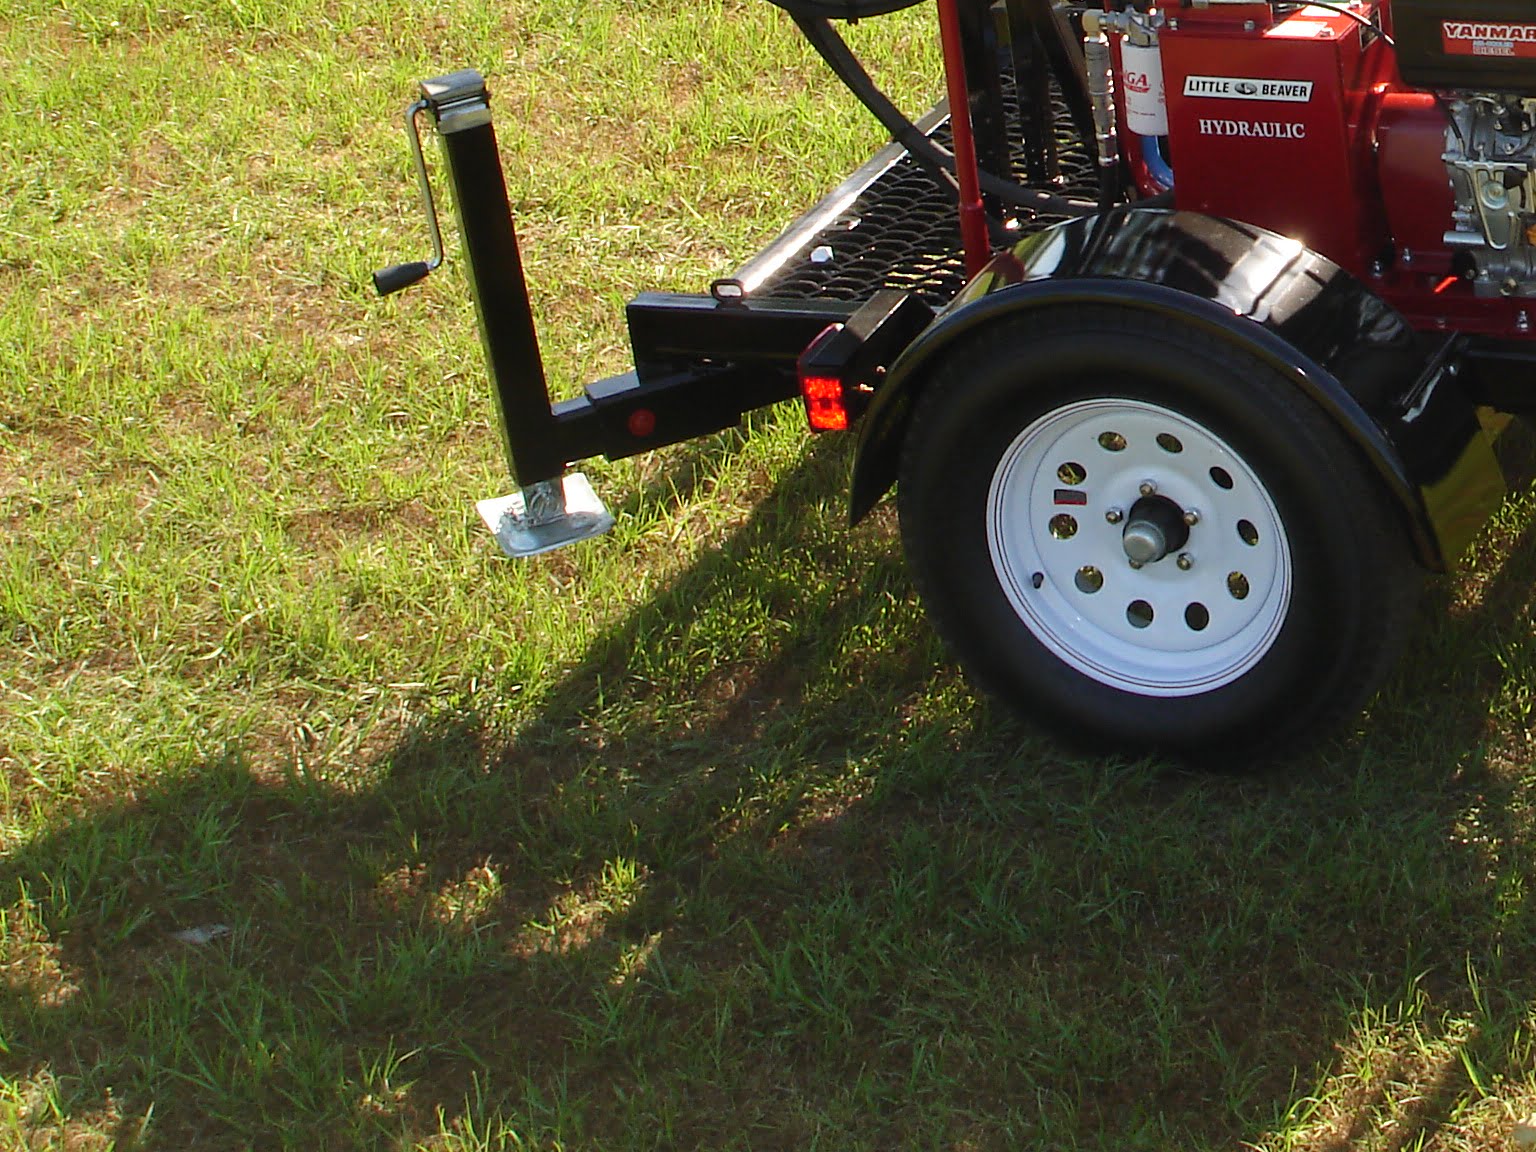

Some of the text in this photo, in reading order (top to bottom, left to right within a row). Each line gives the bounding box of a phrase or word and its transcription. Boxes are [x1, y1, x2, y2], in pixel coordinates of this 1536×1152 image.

[1188, 80, 1308, 98] LITTLE BEAVER
[1198, 119, 1306, 139] HYDRAULIC
